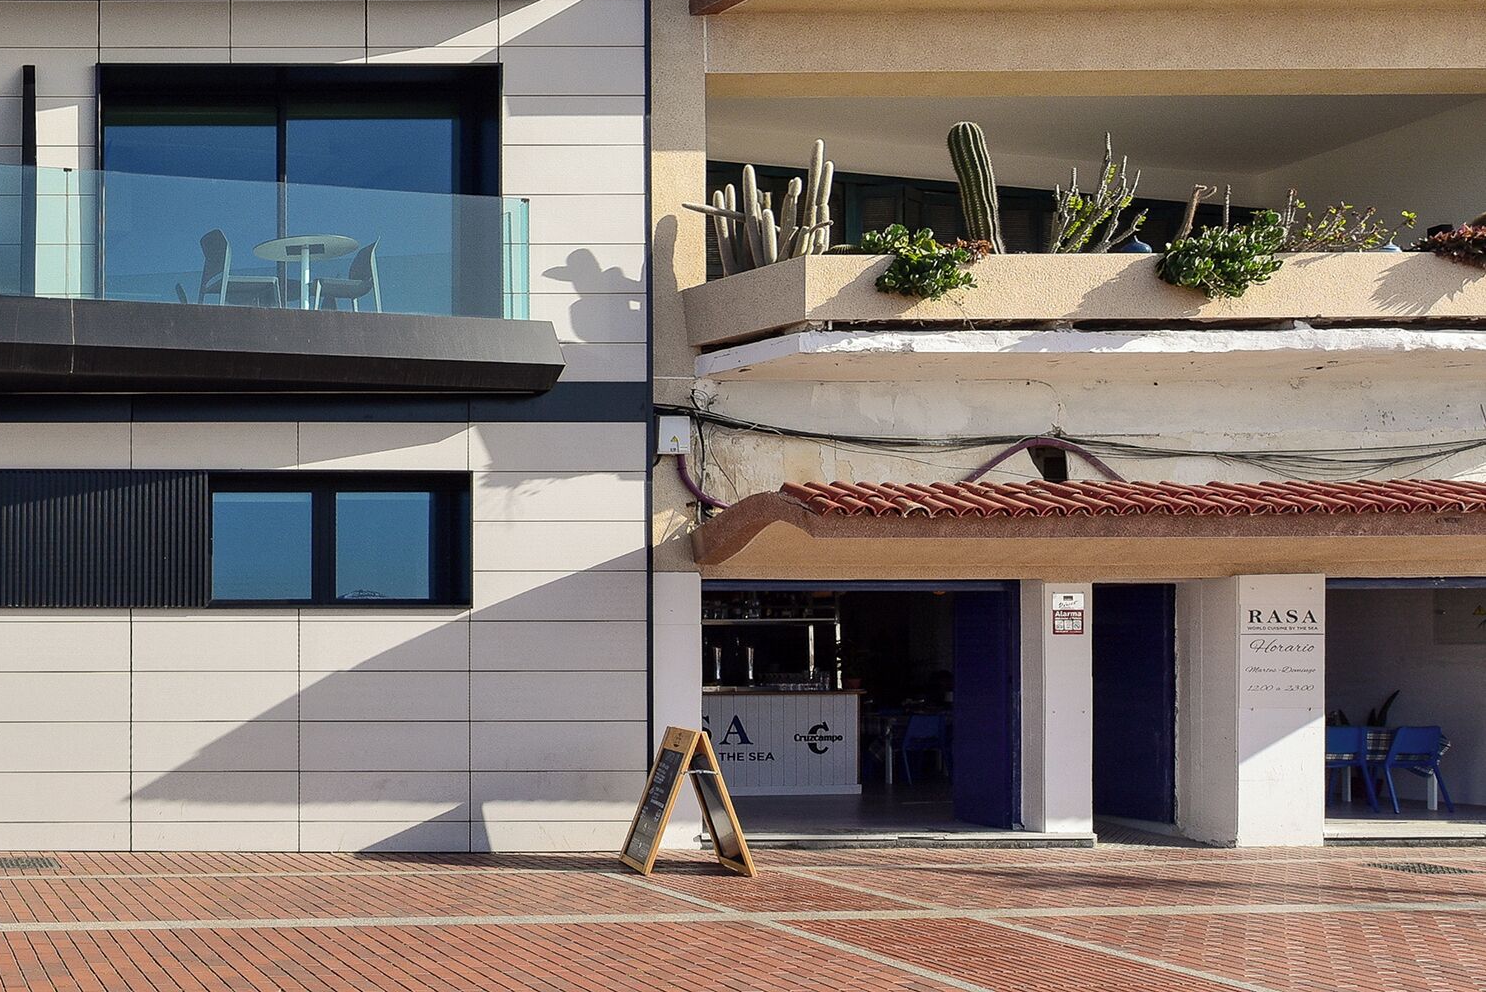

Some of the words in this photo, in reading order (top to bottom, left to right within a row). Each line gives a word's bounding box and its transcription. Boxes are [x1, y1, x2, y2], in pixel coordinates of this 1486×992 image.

[1248, 609, 1317, 623] RASA
[1249, 639, 1315, 653] Horario
[794, 733, 843, 742] Cruzcampo
[719, 752, 745, 761] THE
[749, 752, 774, 761] SEA
